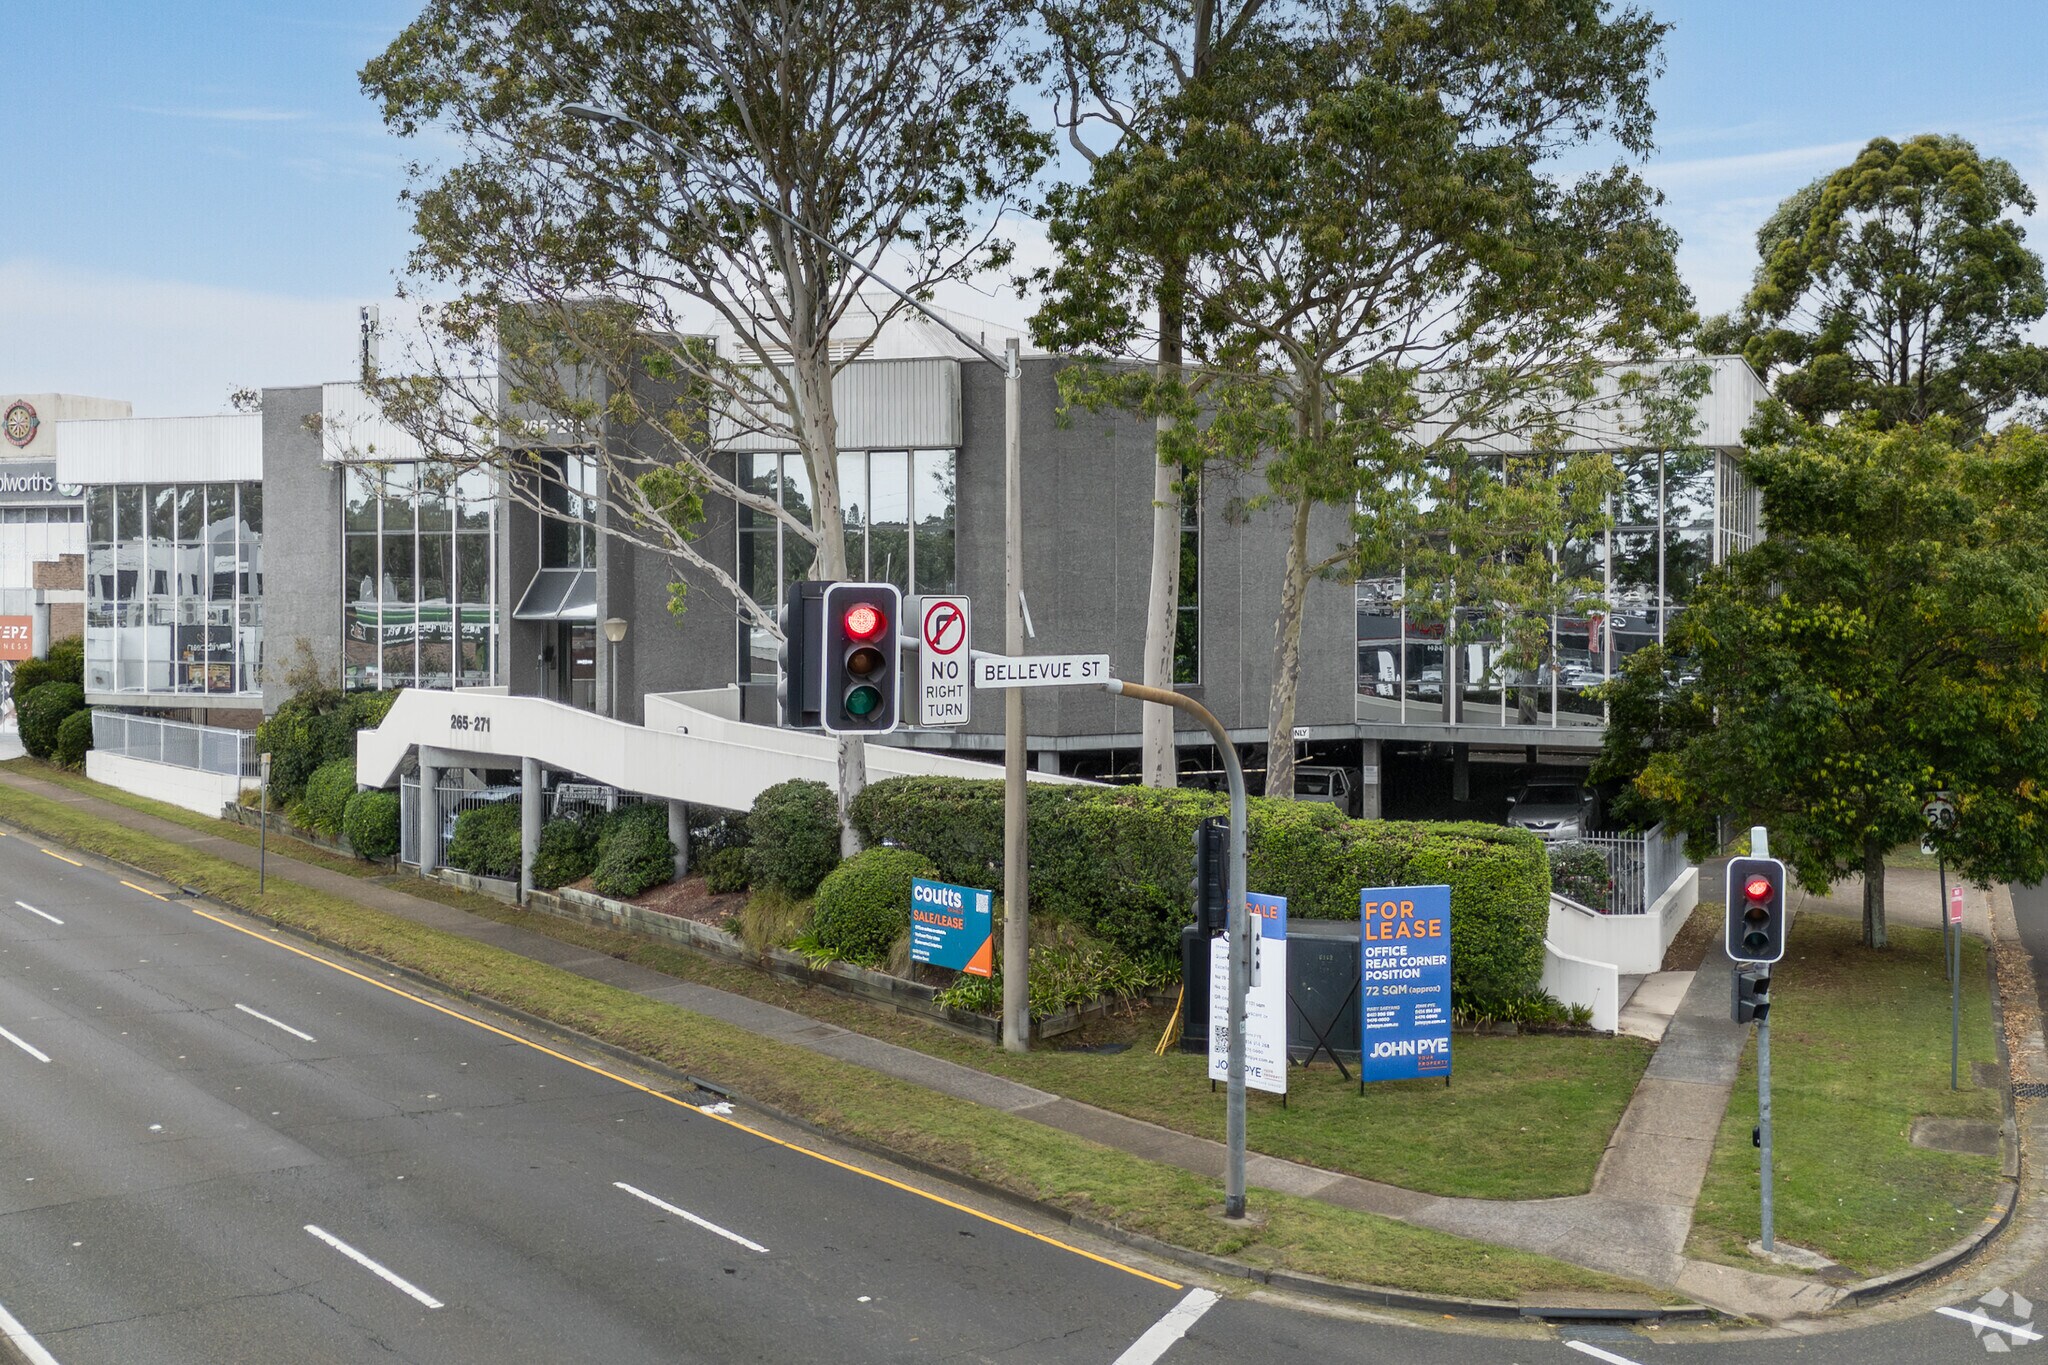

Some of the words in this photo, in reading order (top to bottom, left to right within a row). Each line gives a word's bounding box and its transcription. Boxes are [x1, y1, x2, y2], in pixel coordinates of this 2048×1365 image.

[0, 626, 28, 639] EPZ
[931, 660, 959, 680] NO
[985, 662, 1072, 681] BELLEVUE
[1081, 661, 1101, 677] ST
[926, 684, 964, 699] RIGHT
[928, 703, 963, 717] TURN
[450, 714, 491, 732] 265-271
[1294, 729, 1308, 737] NLY
[1927, 808, 1952, 824] 50
[1365, 900, 1414, 920] FOR
[913, 909, 964, 930] SALE/LEASE
[1365, 919, 1442, 941] LEASE
[1365, 945, 1408, 957] OFFICE
[1365, 957, 1397, 969] REAR
[1399, 955, 1447, 967] CORNER
[1365, 968, 1420, 981] POSITION
[1366, 986, 1379, 996] 72
[1382, 984, 1407, 995] SQM
[1409, 985, 1441, 995] (approx)
[1369, 1040, 1415, 1058] JOHN
[1417, 1037, 1449, 1054] PYE
[1245, 1065, 1262, 1078] PYE
